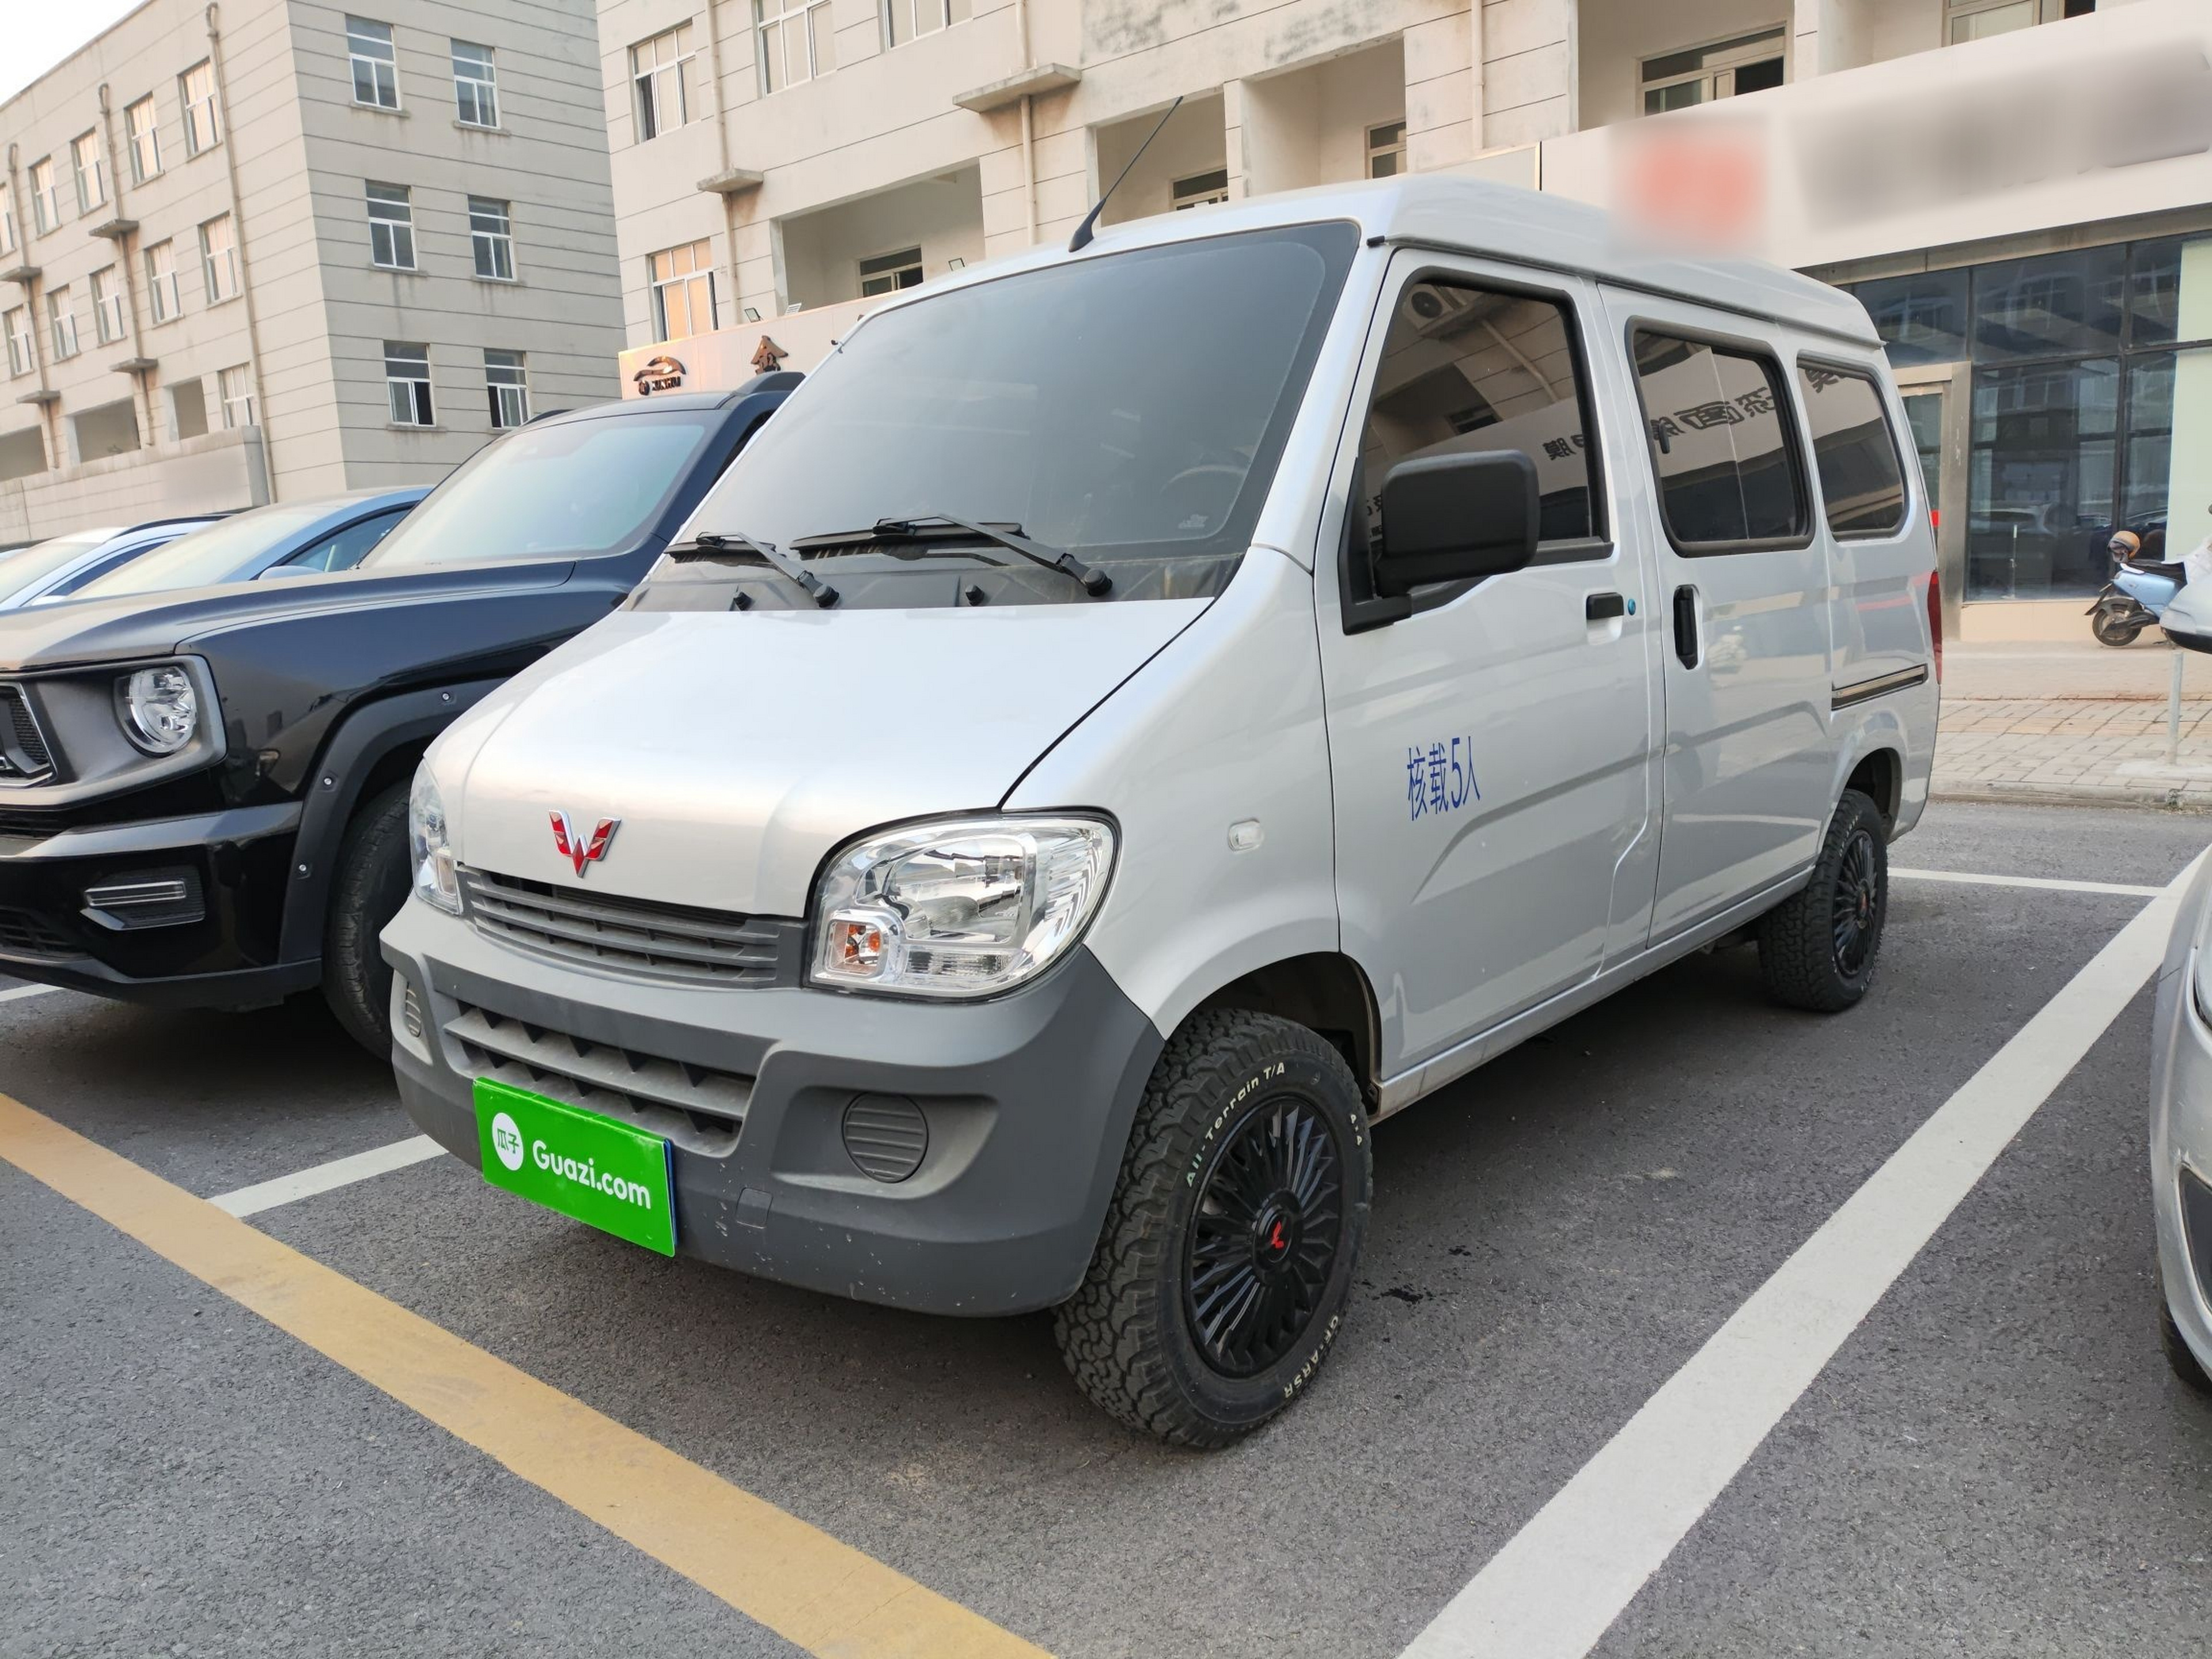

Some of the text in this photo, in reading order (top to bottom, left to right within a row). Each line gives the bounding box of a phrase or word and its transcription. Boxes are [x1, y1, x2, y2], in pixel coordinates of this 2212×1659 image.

[1407, 736, 1480, 821] 核载5人
[497, 1128, 519, 1154] 瓜子
[532, 1139, 652, 1210] Guazi.com
